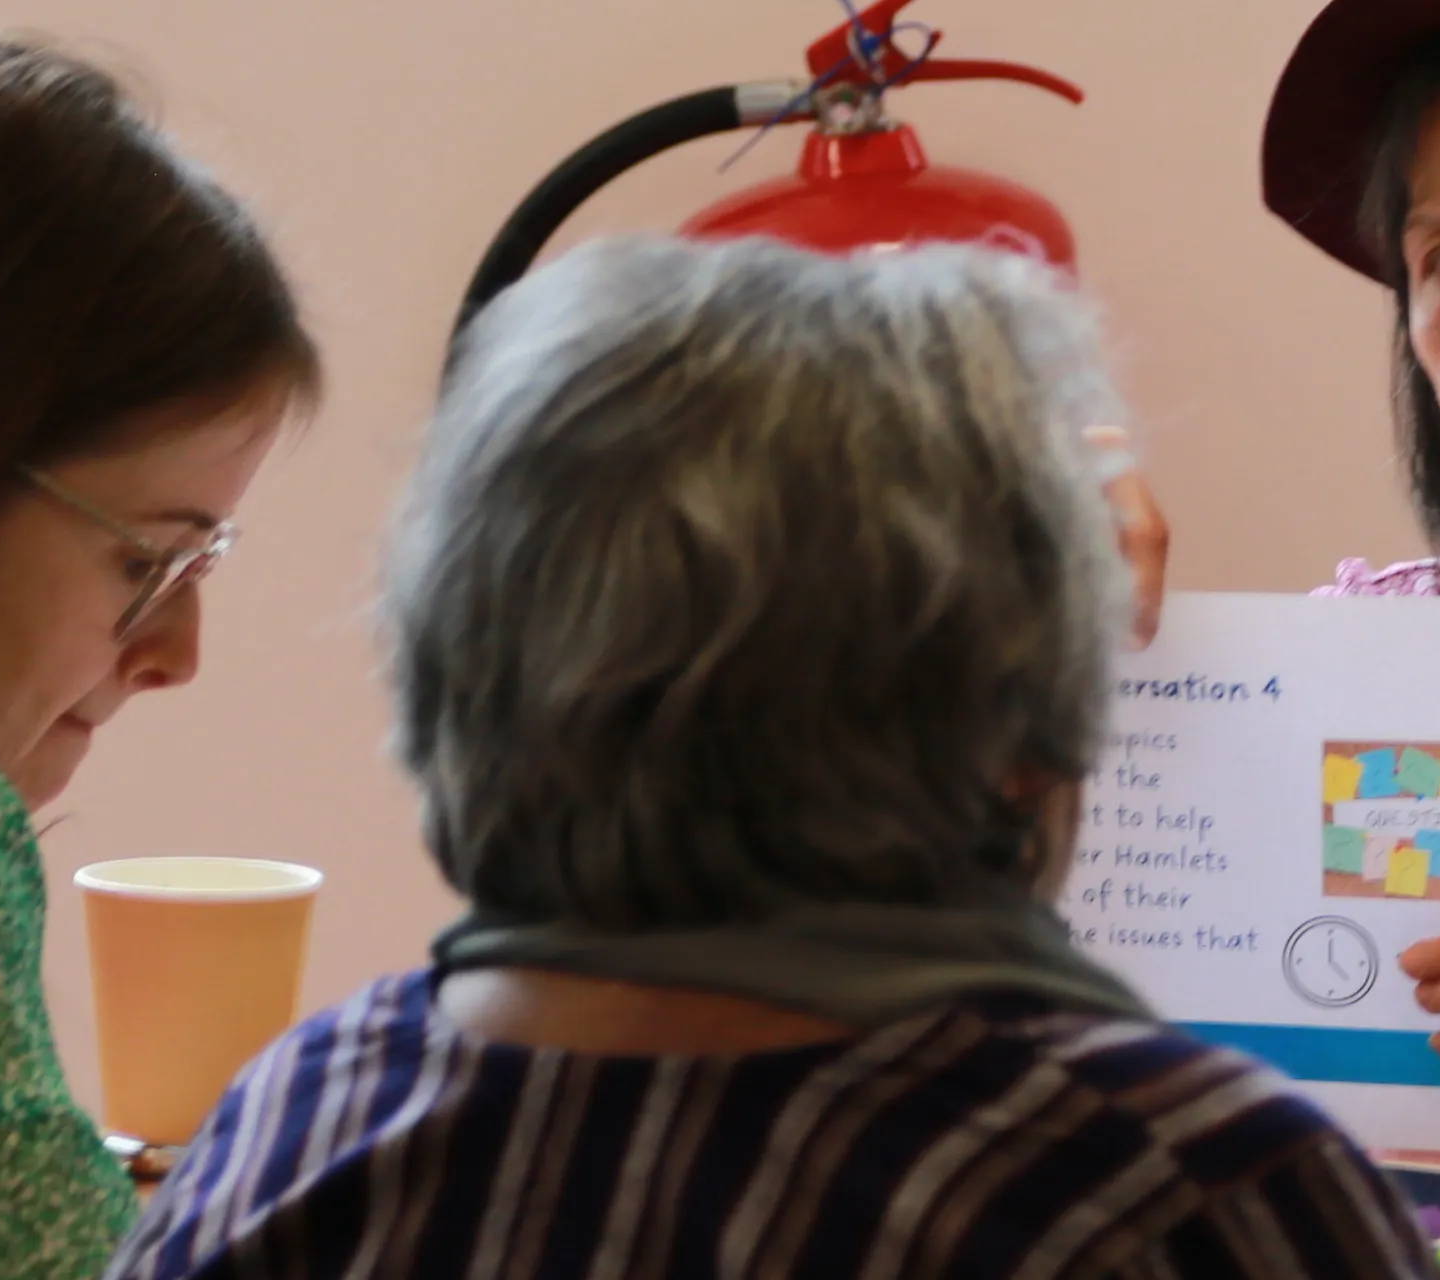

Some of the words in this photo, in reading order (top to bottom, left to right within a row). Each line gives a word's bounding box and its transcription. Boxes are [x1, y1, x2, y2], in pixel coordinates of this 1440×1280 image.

[1118, 673, 1250, 703] ersation
[1262, 675, 1281, 701] 4
[1106, 728, 1178, 758] opics
[1117, 765, 1161, 790] the
[1117, 805, 1144, 827] to
[1156, 804, 1215, 844] help
[1115, 845, 1229, 870] Hamlets
[1082, 878, 1112, 912] of
[1124, 882, 1192, 910] their
[1109, 923, 1183, 949] issues
[1195, 925, 1259, 950] that
